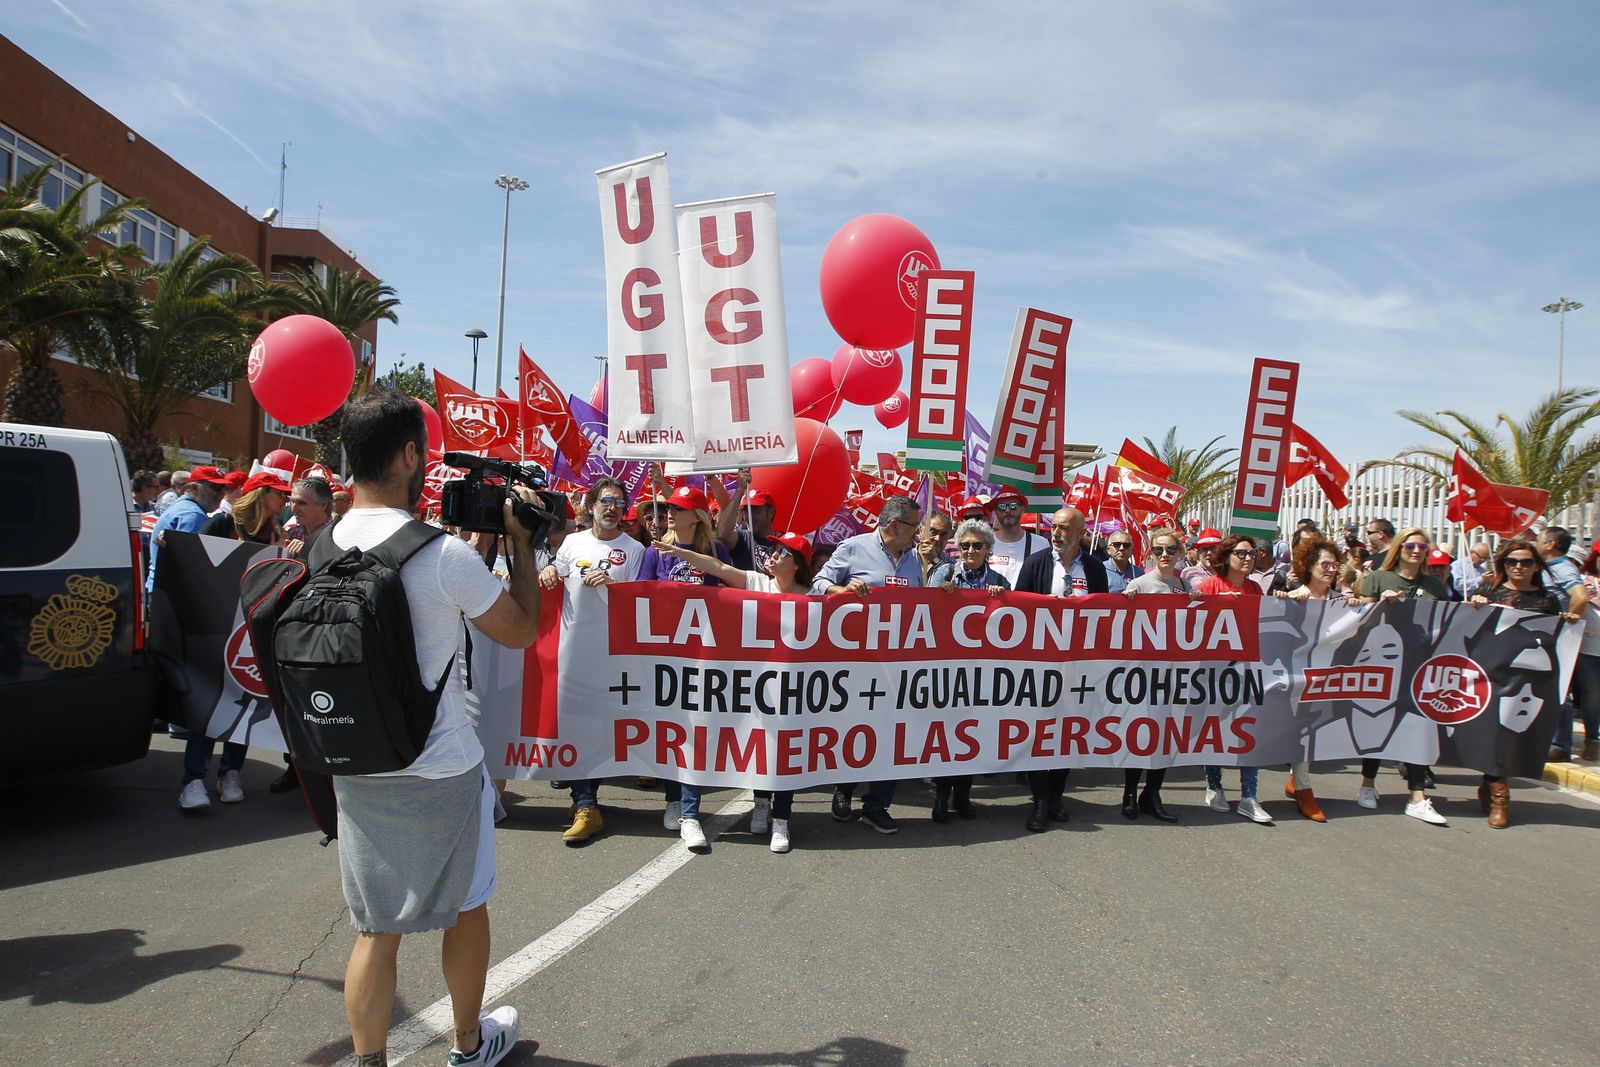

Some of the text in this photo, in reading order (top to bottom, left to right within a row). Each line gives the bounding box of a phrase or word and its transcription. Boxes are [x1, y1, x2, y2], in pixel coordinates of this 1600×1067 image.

[918, 278, 965, 435] CCOO
[1003, 317, 1064, 458] CCOO
[447, 400, 499, 426] UGT
[20, 432, 47, 448] 25A
[582, 426, 608, 457] UG
[616, 426, 685, 444] ALMERÍA
[703, 431, 785, 454] ALMERÍA
[1242, 366, 1291, 507] CCOO
[886, 577, 908, 586] CCOO
[1072, 578, 1088, 587] CCO
[635, 597, 1244, 651] LA LUCHA CONTINÚA
[654, 663, 850, 716] DERECHOS
[896, 666, 1063, 709] IGUALDAD
[1105, 660, 1265, 706] COHESIÓN
[1307, 672, 1385, 694] CCOO
[1422, 665, 1480, 696] UGT
[505, 741, 578, 768] MAYO
[613, 715, 1258, 776] PRIMERO LAS PERSONAS
